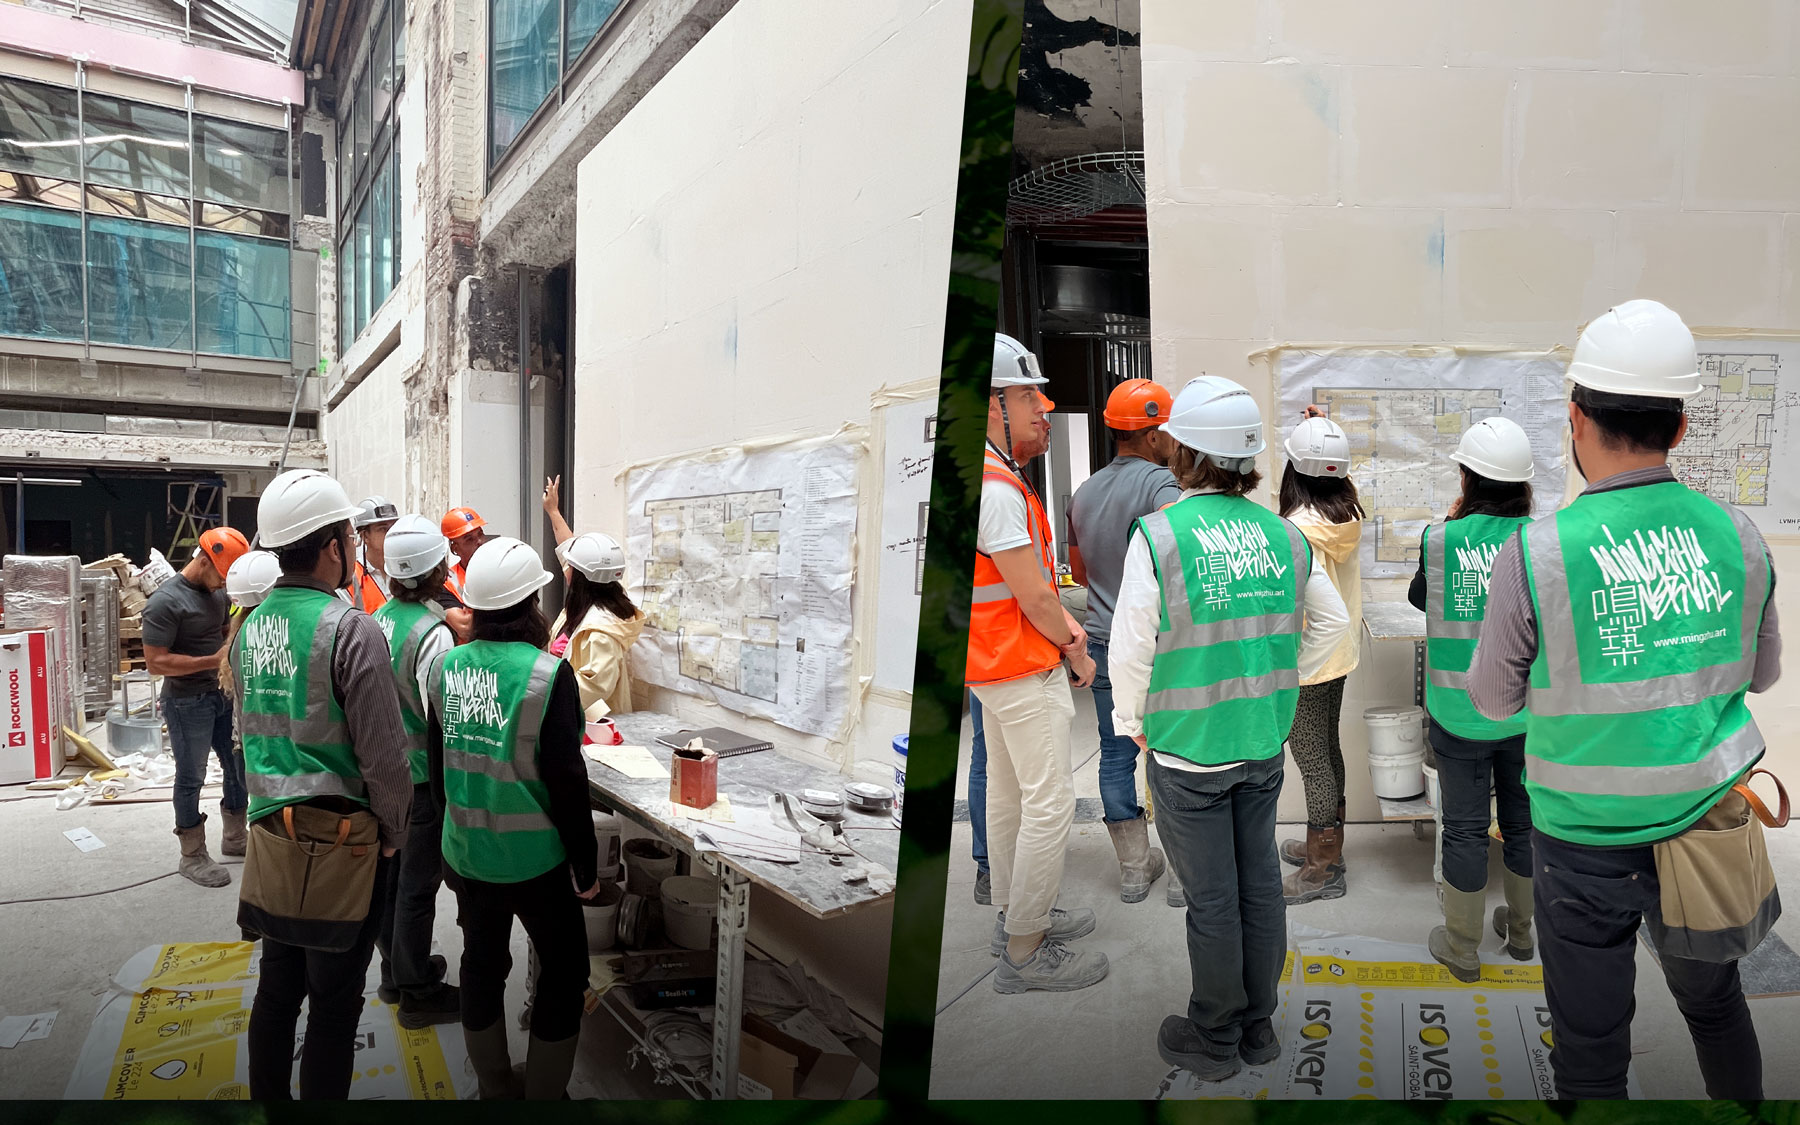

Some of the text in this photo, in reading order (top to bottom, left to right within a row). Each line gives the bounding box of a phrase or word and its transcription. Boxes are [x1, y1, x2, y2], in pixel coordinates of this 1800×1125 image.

[9, 668, 21, 729] ROCKWOOL
[113, 1047, 137, 1100] LIMCOVER
[130, 1061, 143, 1077] 224
[1408, 1044, 1420, 1100] SAINT-GOBA
[1532, 1048, 1555, 1100] SAINT-GOBA
